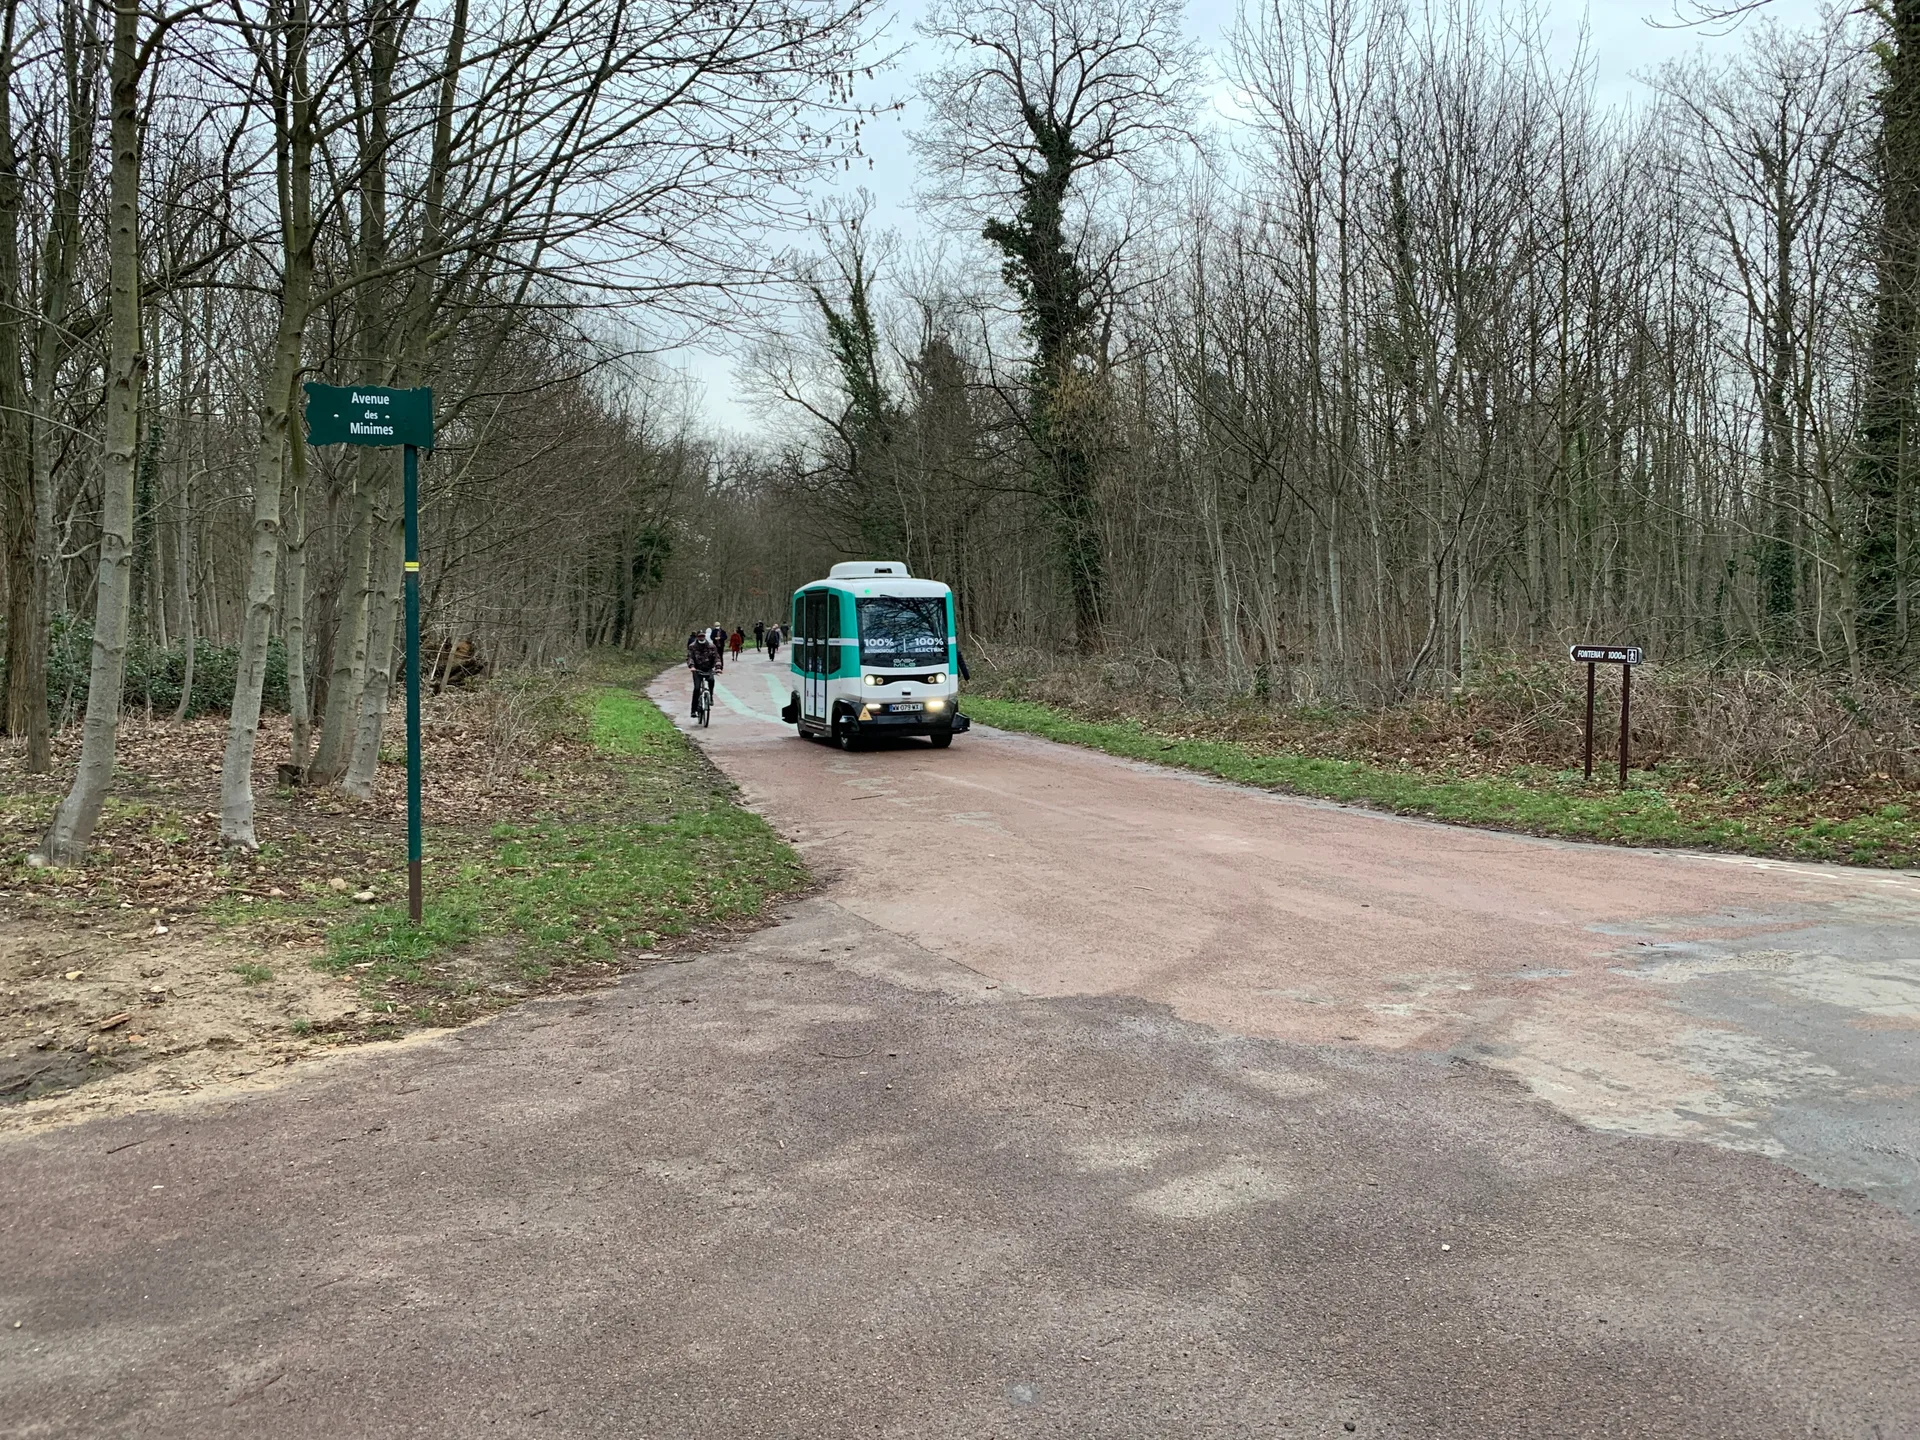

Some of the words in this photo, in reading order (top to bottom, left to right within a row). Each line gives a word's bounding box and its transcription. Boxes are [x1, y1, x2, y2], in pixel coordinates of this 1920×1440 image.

[351, 392, 390, 405] Avenue
[364, 410, 378, 420] des
[350, 422, 394, 435] Minimes
[864, 638, 894, 647] 100%
[914, 637, 944, 646] 100%
[1577, 650, 1605, 659] FONTENAY
